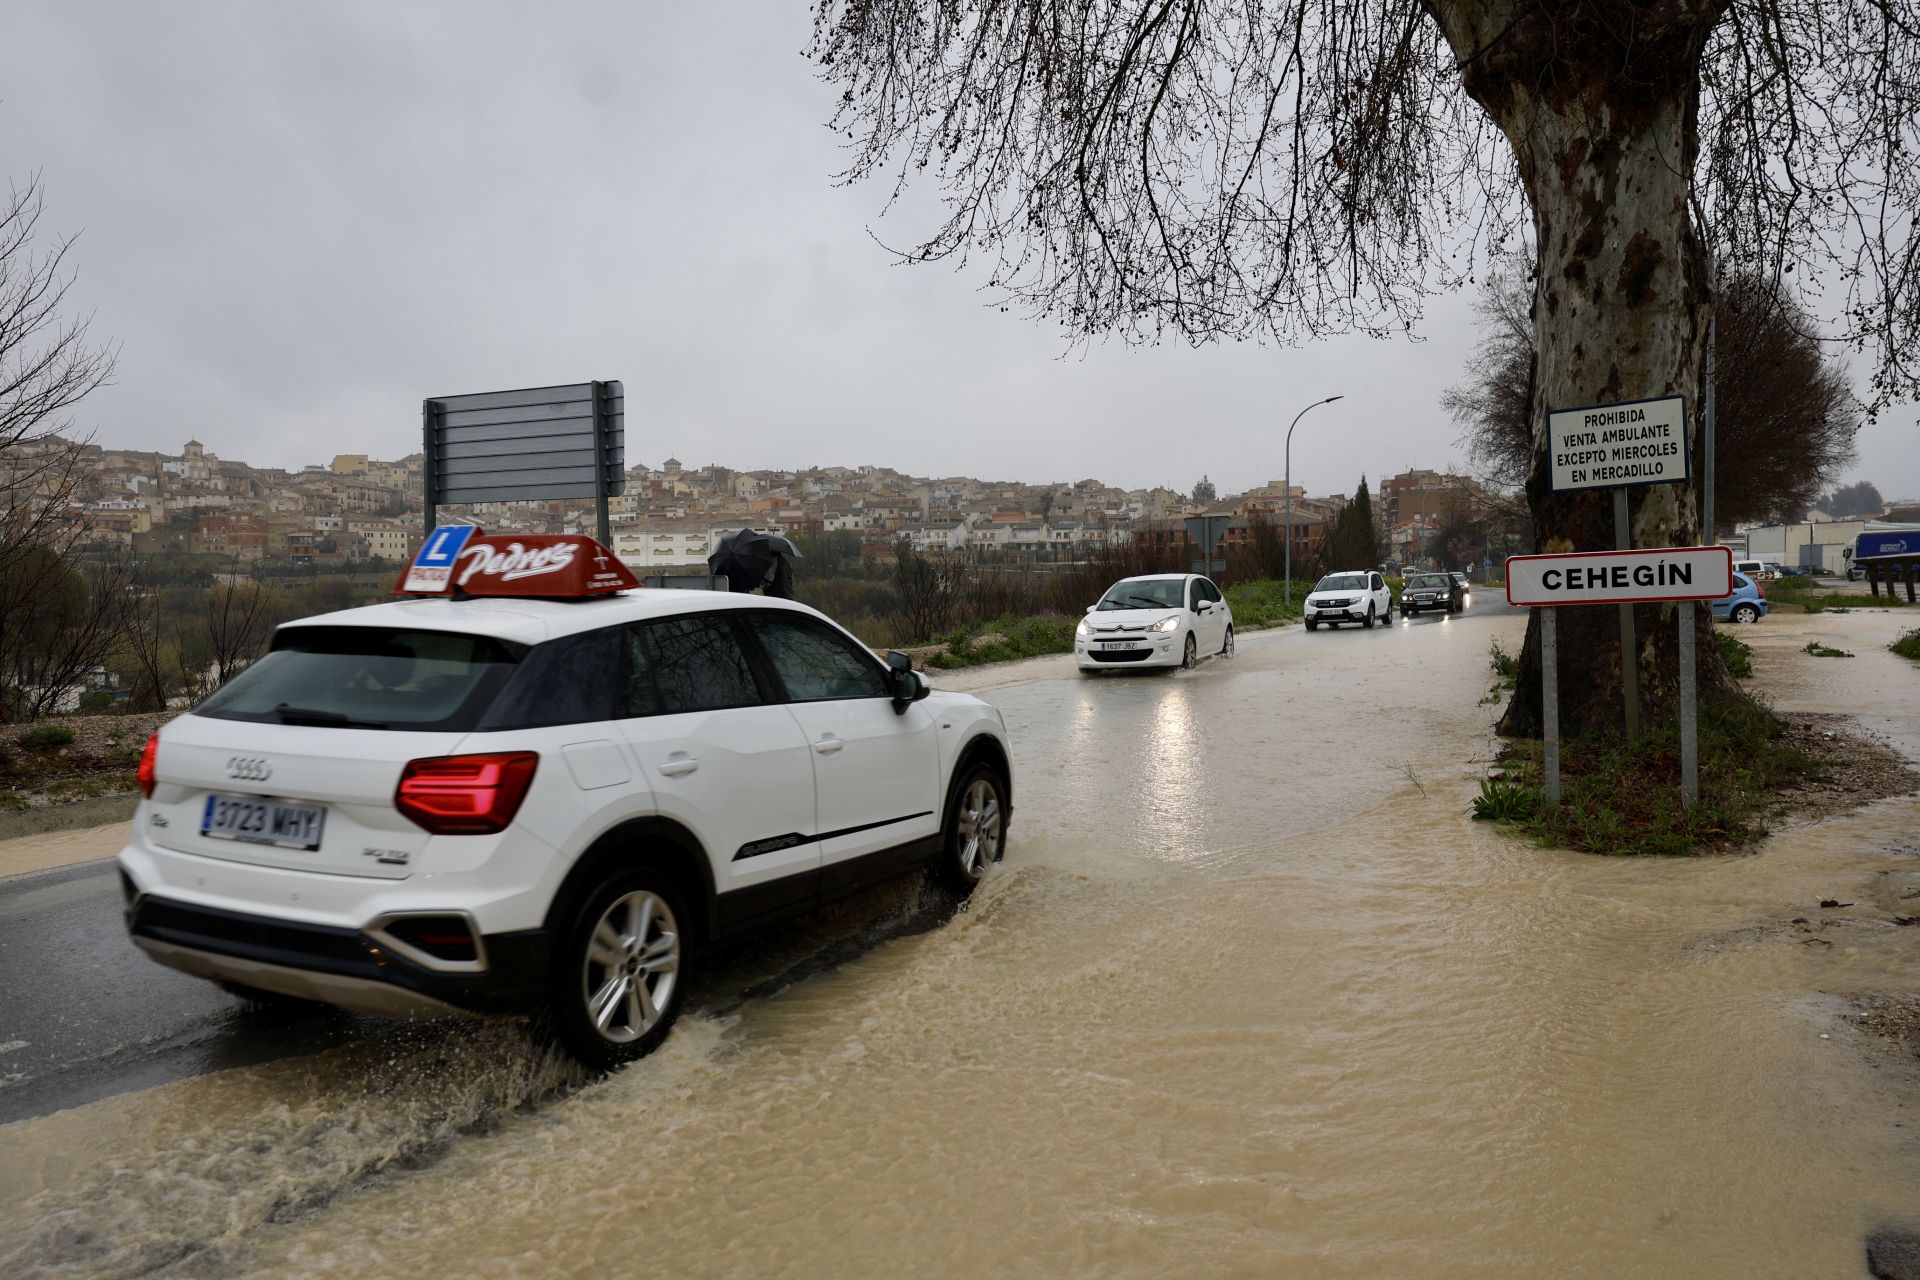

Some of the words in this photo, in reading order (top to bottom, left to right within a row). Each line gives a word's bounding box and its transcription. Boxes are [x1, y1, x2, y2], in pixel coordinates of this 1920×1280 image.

[1585, 409, 1645, 428] PROHIBIDA
[1563, 432, 1597, 448] VENTA
[1602, 424, 1670, 443] AMBULANTE
[1557, 450, 1606, 467] EXCEPTO
[1612, 442, 1678, 461] MIERCOLES
[1572, 469, 1587, 483] EN
[1592, 462, 1664, 481] MERCADILLO
[426, 532, 450, 560] L
[1541, 560, 1692, 591] CEHEGÍN
[1123, 642, 1135, 650] JBZ
[215, 801, 267, 832] 3723
